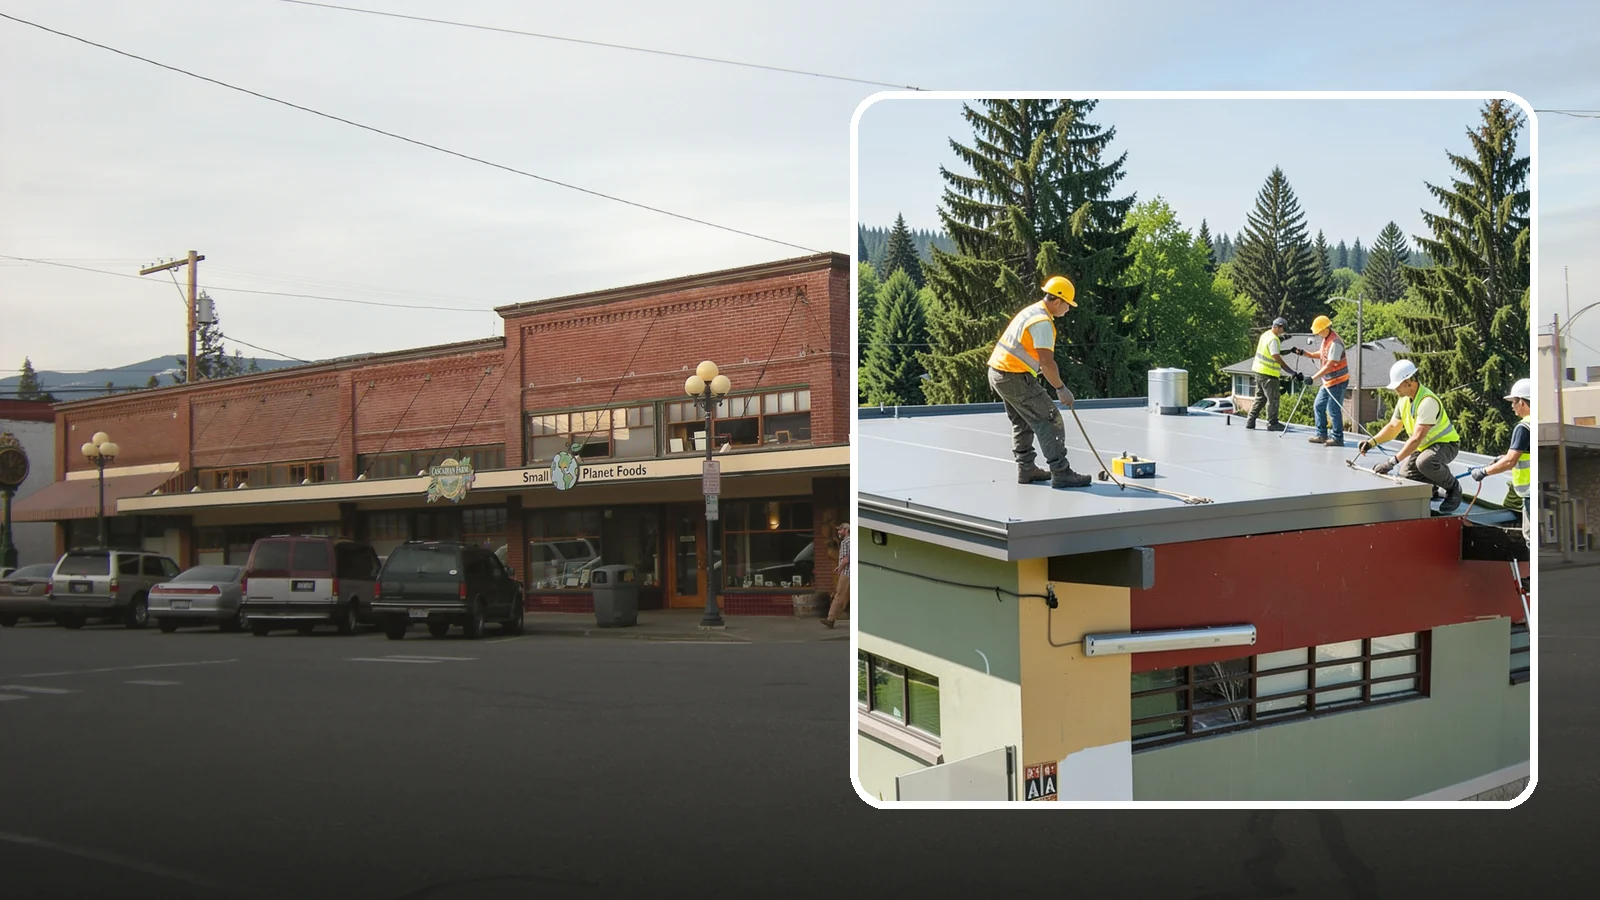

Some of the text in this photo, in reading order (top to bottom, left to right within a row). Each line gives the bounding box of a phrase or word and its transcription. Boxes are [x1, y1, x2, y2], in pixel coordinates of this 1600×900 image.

[523, 464, 647, 482] Small Planet Foods
[1028, 777, 1056, 799] A A
